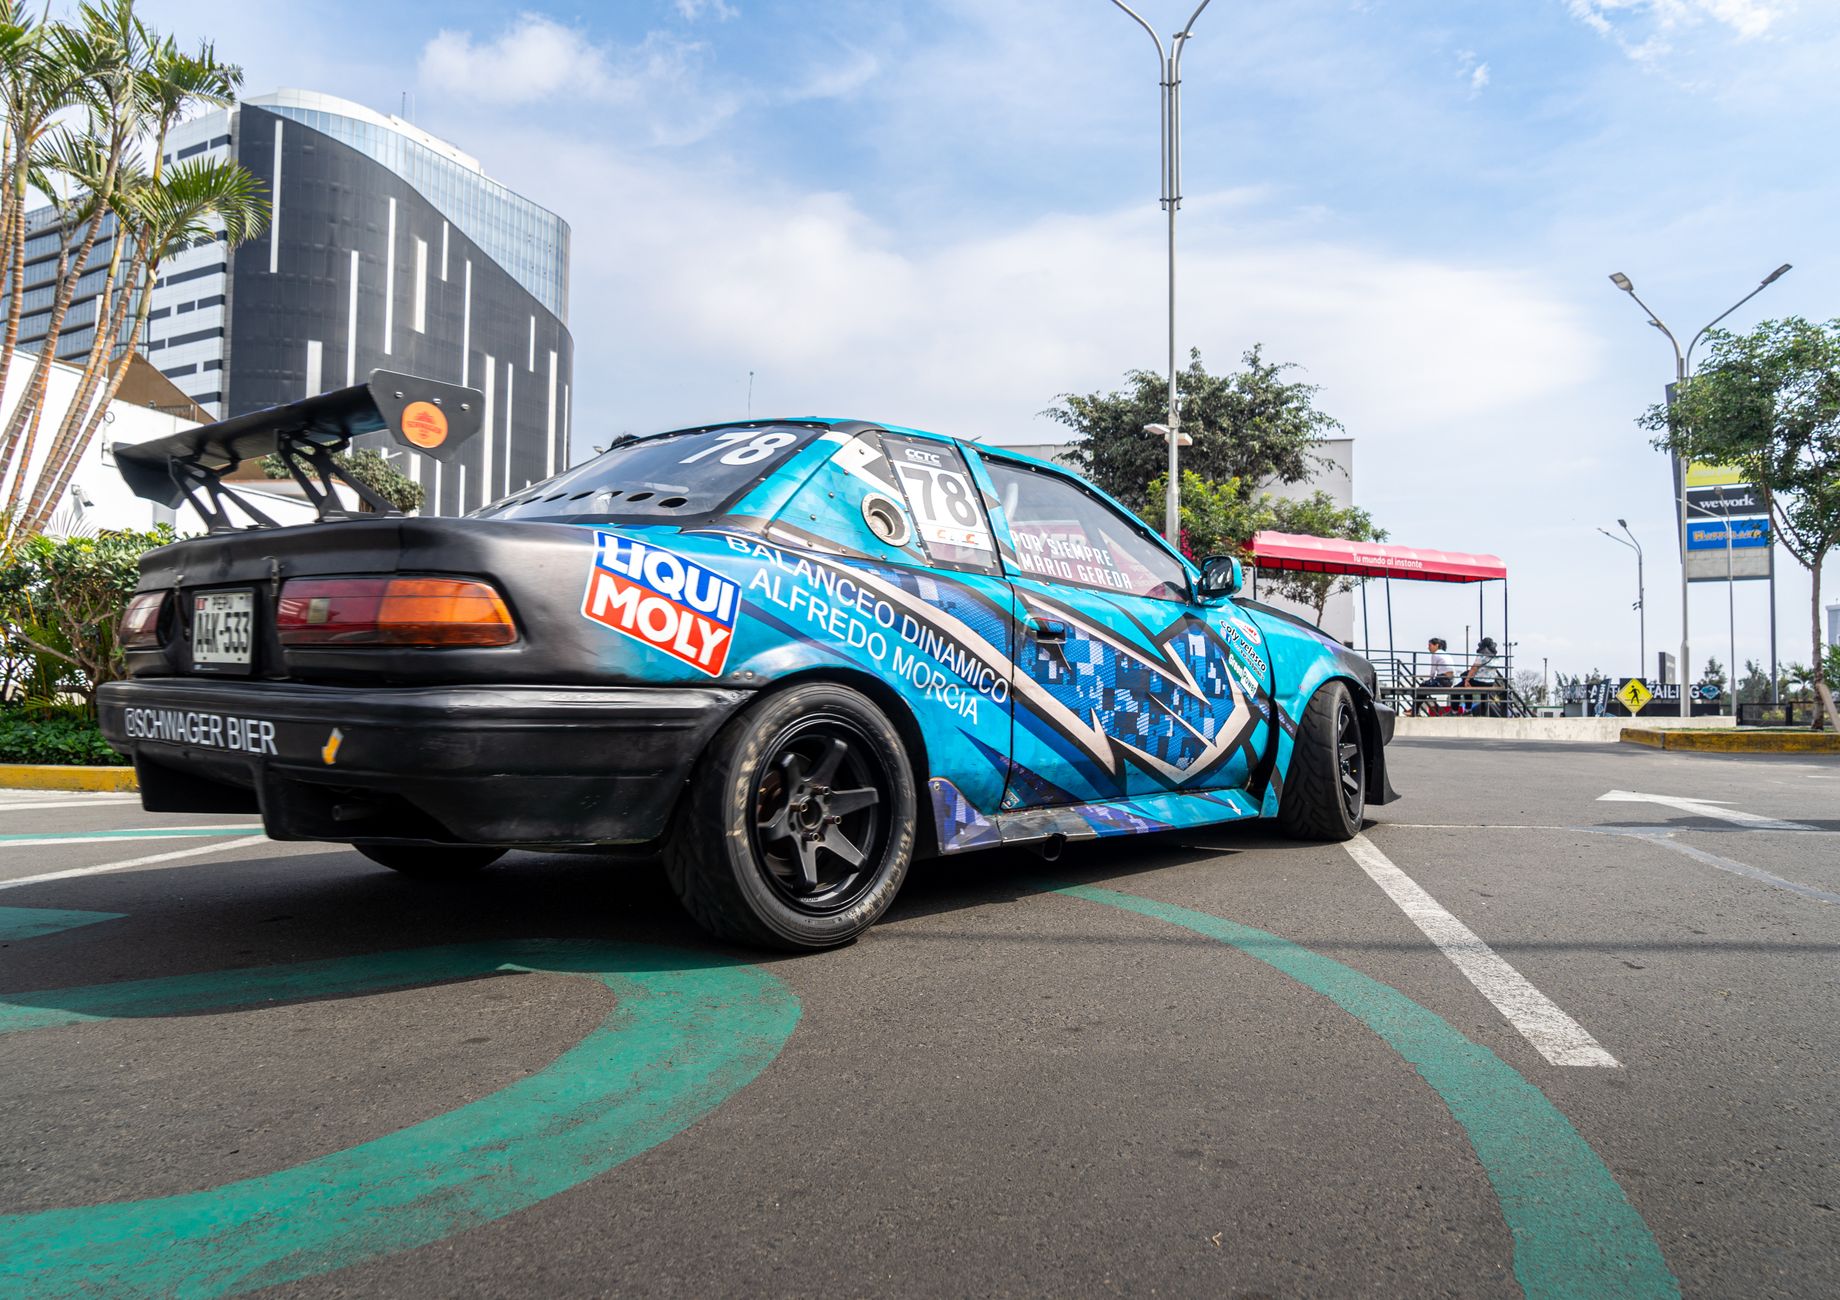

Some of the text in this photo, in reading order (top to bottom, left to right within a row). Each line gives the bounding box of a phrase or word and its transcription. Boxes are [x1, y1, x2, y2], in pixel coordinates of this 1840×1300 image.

[679, 431, 798, 466] 78
[905, 448, 940, 462] CCTC
[900, 466, 977, 527] 78
[1699, 494, 1755, 509] wework
[1010, 529, 1044, 553] POR
[1047, 538, 1113, 567] SIEMPRE
[1352, 553, 1423, 569] Tu mundo al instante
[601, 535, 735, 622] LIQUI
[1020, 552, 1133, 590] MARIO GEREDA
[195, 611, 250, 654] A4K-533
[592, 573, 731, 666] MOLY
[726, 536, 1009, 704] BALANCEO DINAMICO
[748, 568, 979, 724] ALFREDO MORCIA
[124, 707, 279, 756] @SCHWAGER BIER
